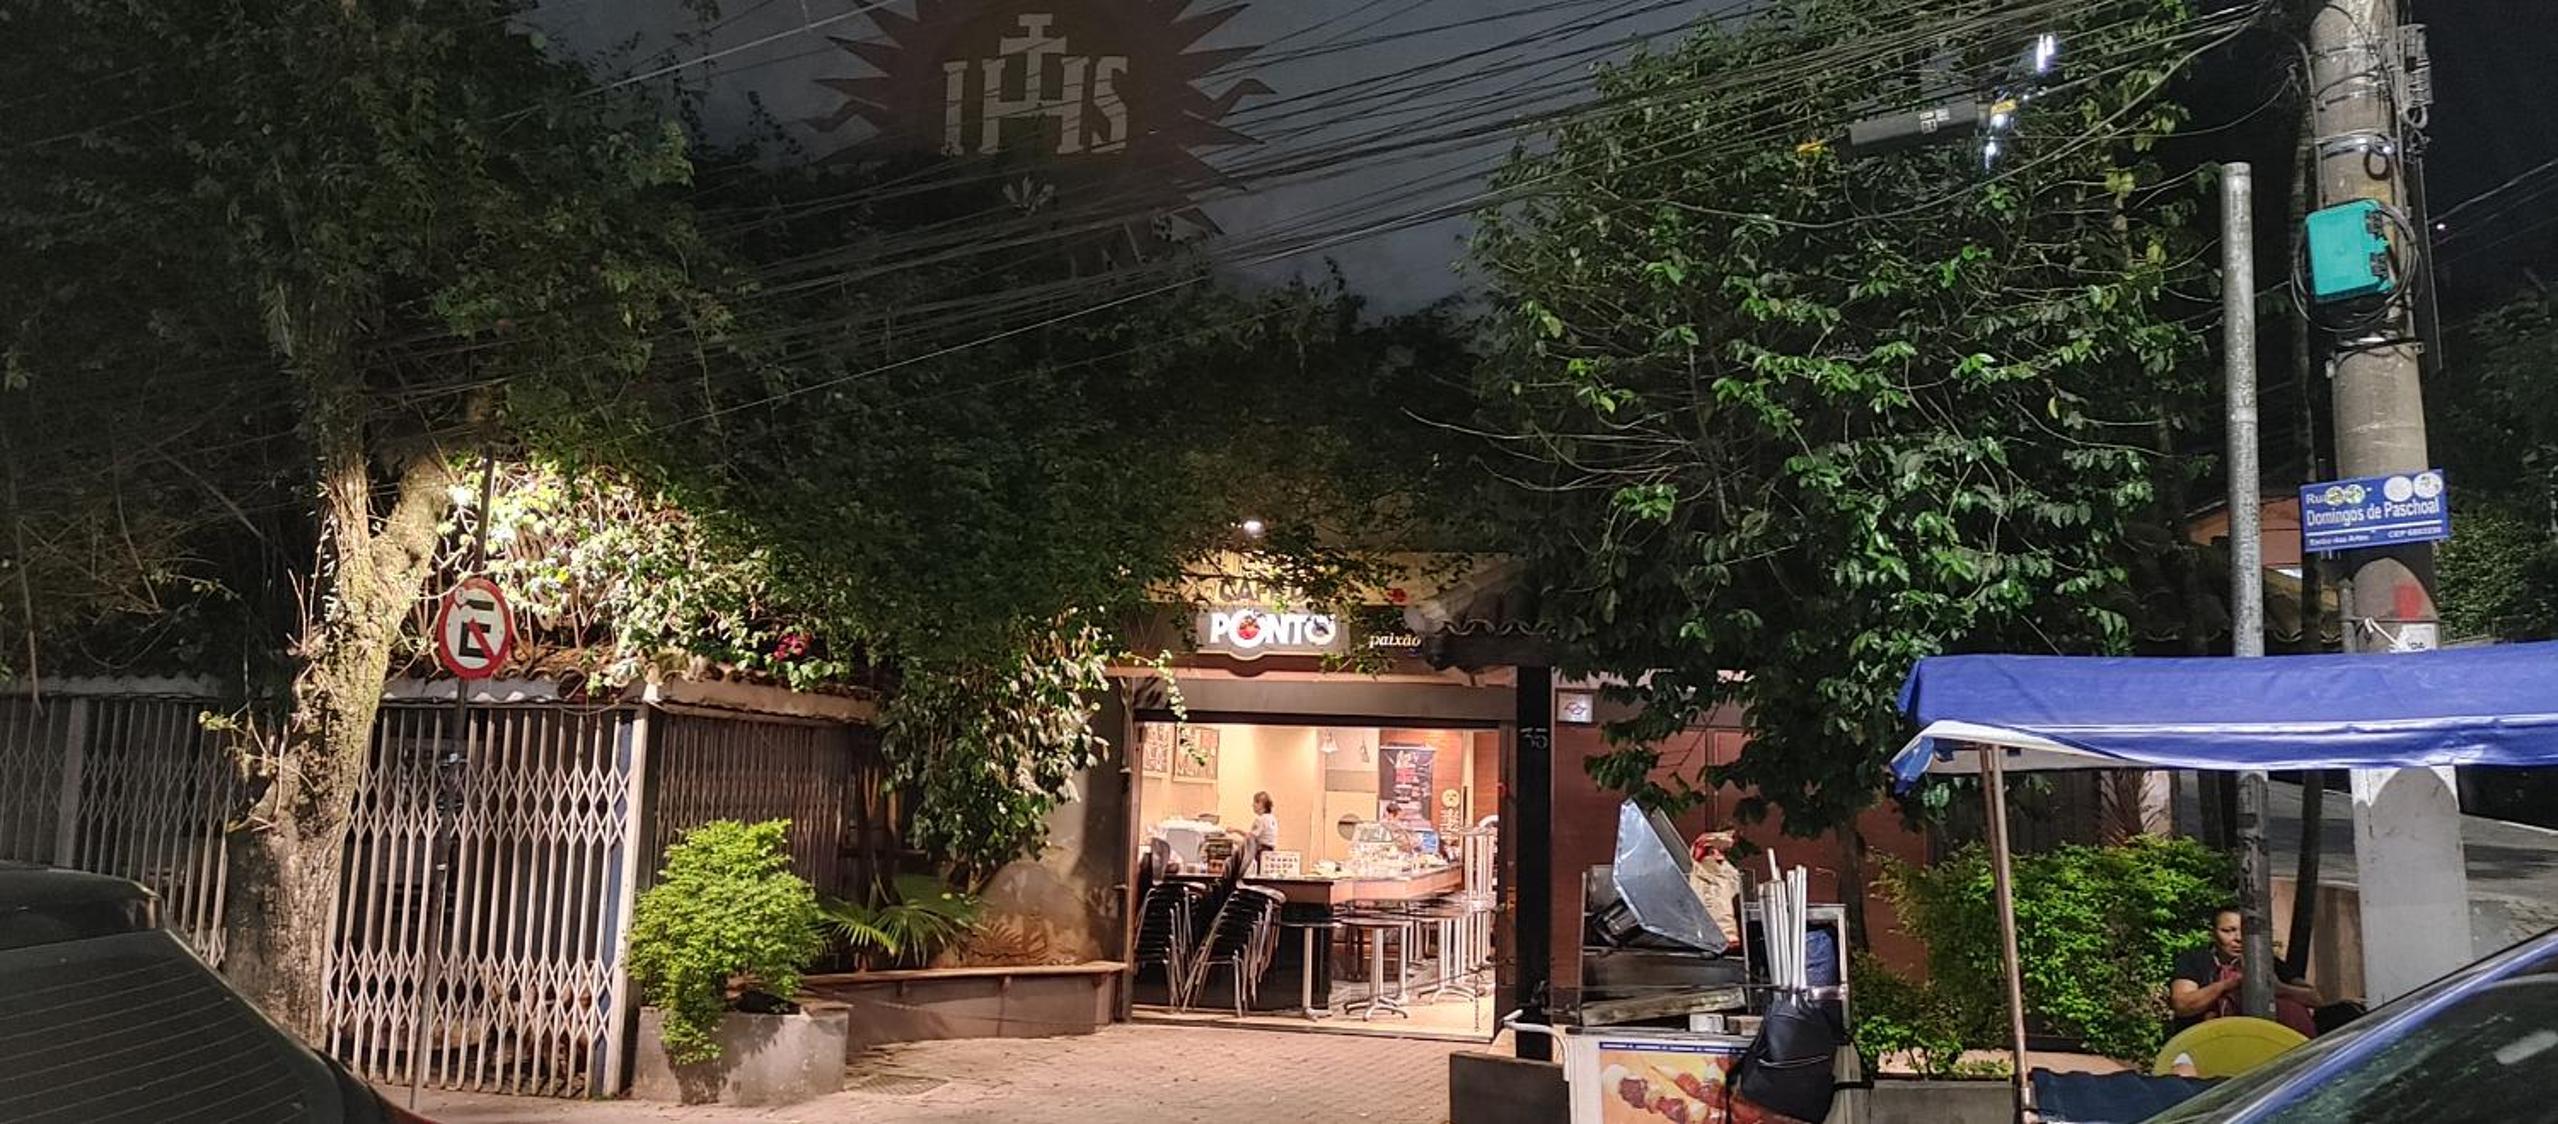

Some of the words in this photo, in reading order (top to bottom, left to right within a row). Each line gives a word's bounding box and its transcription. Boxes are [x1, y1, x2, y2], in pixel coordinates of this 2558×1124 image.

[940, 14, 1128, 156] IHS
[2307, 507, 2364, 527] Domingos
[2367, 503, 2382, 520] de
[2384, 498, 2440, 518] Paschoal
[1210, 608, 1336, 648] PONTO
[1369, 633, 1421, 649] paixão
[1520, 727, 1548, 750] 35
